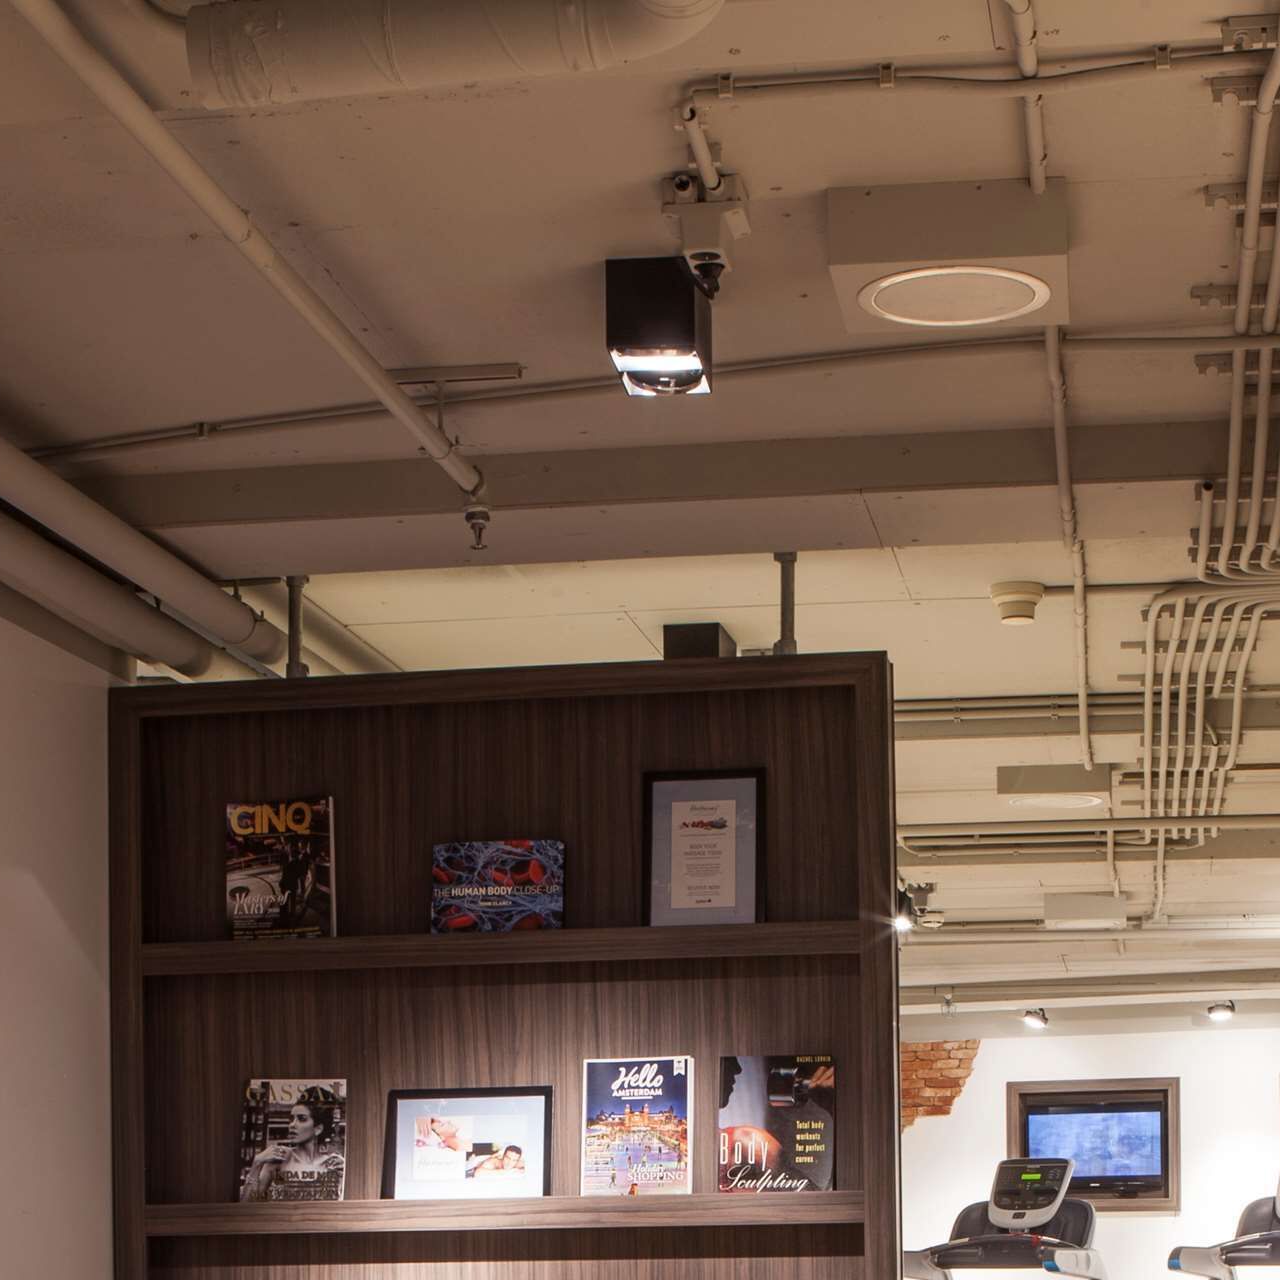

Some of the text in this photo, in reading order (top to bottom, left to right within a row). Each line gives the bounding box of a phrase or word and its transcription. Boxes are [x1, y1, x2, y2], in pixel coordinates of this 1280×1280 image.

[230, 801, 312, 836] CINQ
[433, 884, 560, 897] THE HUMAN BODY CLOSE-UP
[610, 1063, 664, 1089] Hello
[612, 1088, 663, 1098] AMSTERDAM
[796, 1120, 825, 1131] Total body
[796, 1132, 821, 1141] workouts
[720, 1132, 769, 1172] Body
[796, 1143, 825, 1153] for perfect
[627, 1171, 684, 1182] SHOPPING
[719, 1164, 809, 1193] Sculpting
